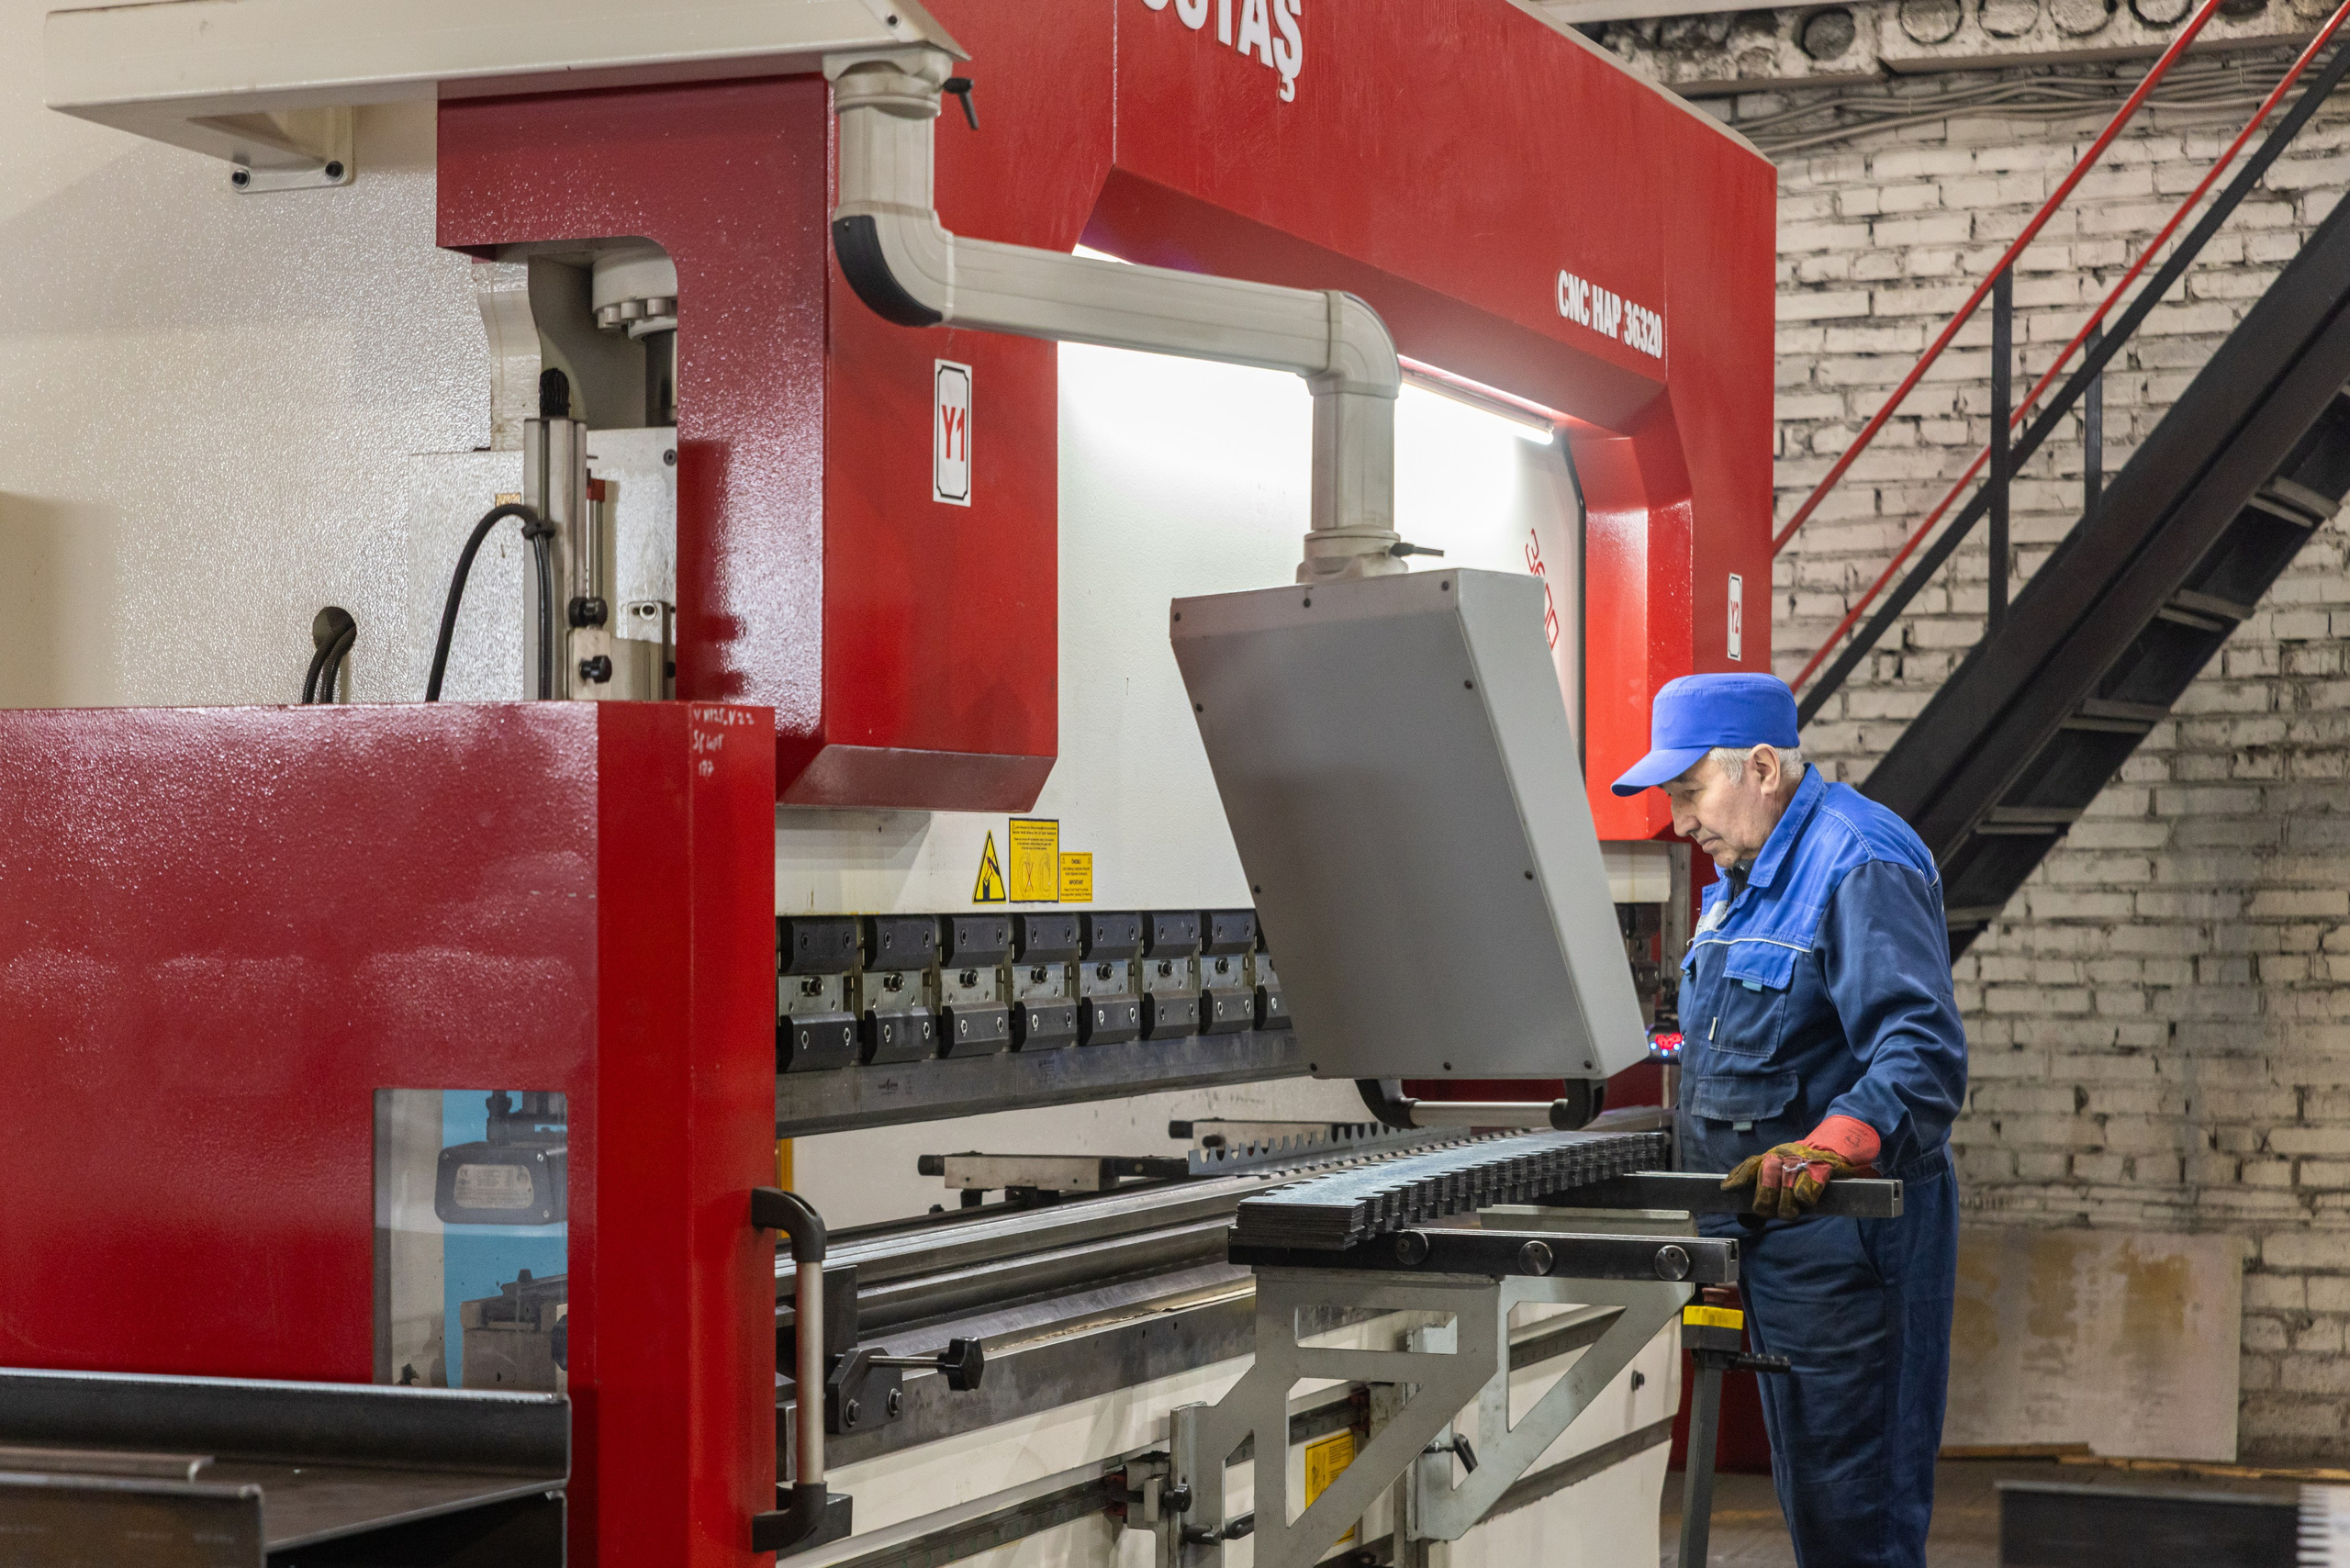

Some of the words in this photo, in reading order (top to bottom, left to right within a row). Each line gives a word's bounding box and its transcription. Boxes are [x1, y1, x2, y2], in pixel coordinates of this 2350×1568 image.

[1558, 269, 1589, 326] CNC
[1592, 285, 1621, 339] HAP
[1624, 299, 1662, 359] 36320
[941, 404, 965, 462] Y1
[1729, 599, 1740, 634] Y2
